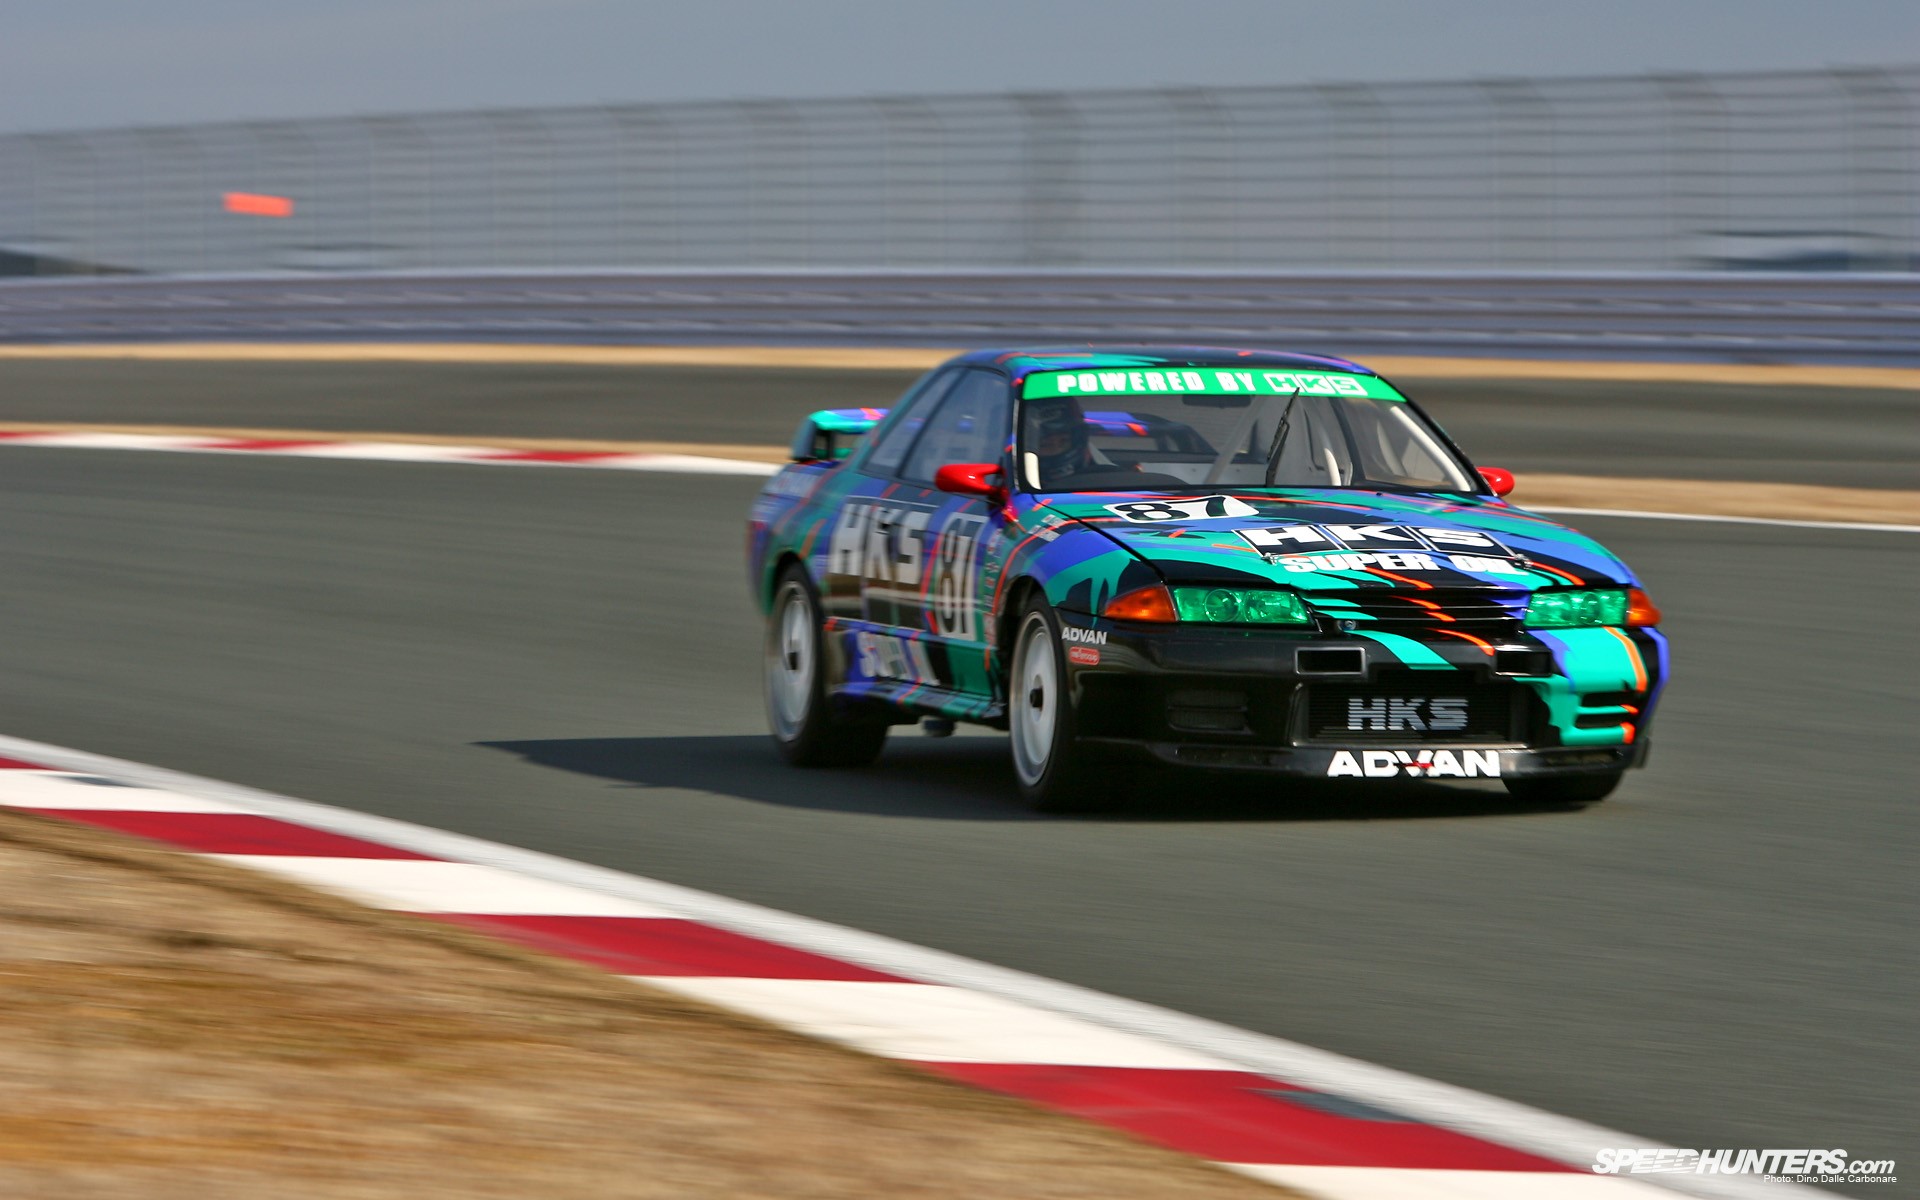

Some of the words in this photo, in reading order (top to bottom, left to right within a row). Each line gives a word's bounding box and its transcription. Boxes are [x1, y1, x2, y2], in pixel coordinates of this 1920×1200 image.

[1057, 371, 1206, 393] POWERED
[1215, 372, 1256, 391] BY
[1263, 373, 1368, 396] HKS
[1114, 495, 1230, 521] 87
[828, 503, 932, 584] HKS
[1239, 524, 1496, 549] HKS
[1280, 553, 1441, 573] SUPER
[1448, 554, 1529, 576] OIL
[1061, 627, 1107, 645] ADVAN
[1347, 698, 1469, 731] HKS
[1327, 750, 1501, 778] ADVAN
